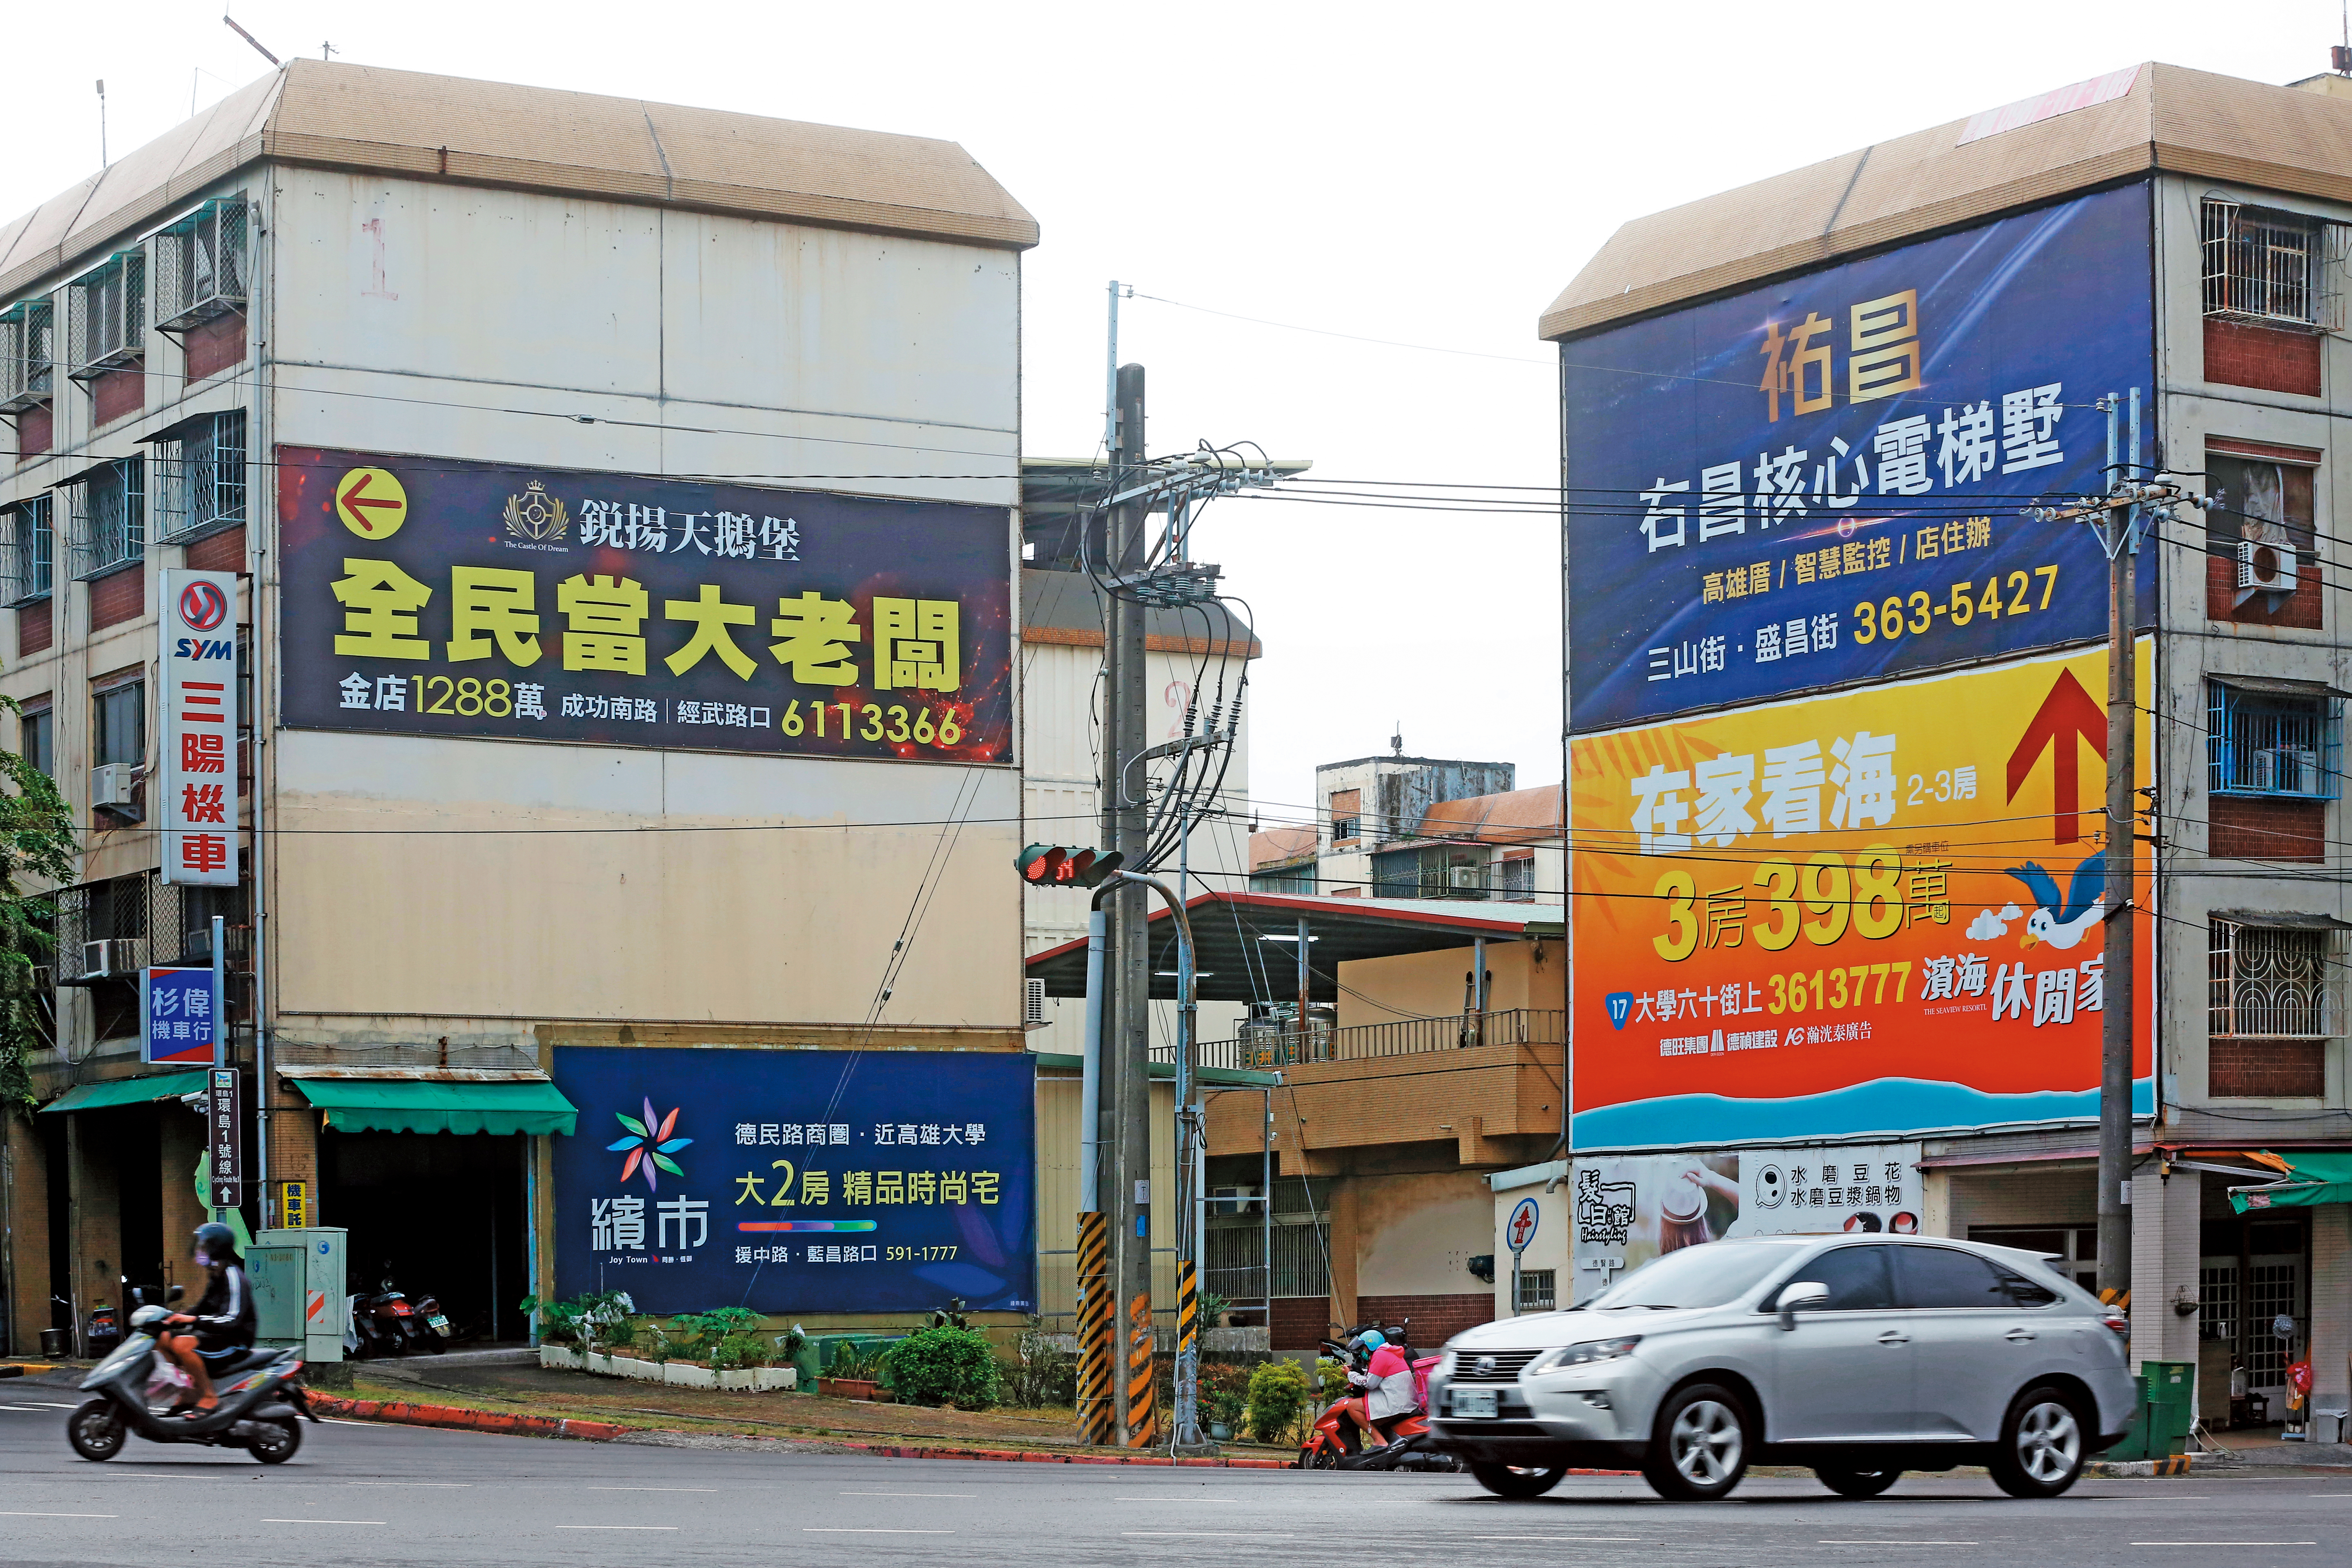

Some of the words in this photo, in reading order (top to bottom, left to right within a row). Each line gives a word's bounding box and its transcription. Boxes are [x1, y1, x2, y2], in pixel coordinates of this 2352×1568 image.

[1759, 289, 1921, 423] 祐昌
[1639, 382, 2064, 553] 右昌核心電梯墅
[548, 545, 568, 553] Dream
[1703, 561, 1771, 604] 高雄厝
[1795, 537, 1891, 585] 智慧監控
[1916, 517, 1991, 560] 店住辦
[330, 557, 960, 693] 全民當大老闆
[1853, 564, 2059, 646] 363-5427
[174, 638, 232, 661] SYM
[561, 694, 657, 724] 成功南路
[677, 699, 770, 728] 經武路口
[782, 699, 960, 745] 6113366
[181, 682, 226, 872] 三陽機車
[1631, 731, 1897, 858] 在家看海
[1907, 765, 1977, 806] 2-3房
[152, 987, 210, 1017] 杉偉
[1613, 999, 1627, 1019] 17
[1635, 982, 1762, 1023] 大學六十街上
[1768, 961, 1911, 1014] 3613777
[1936, 1006, 1961, 1014] SEAVIEW
[152, 1020, 211, 1041] 機車行
[1660, 1036, 1708, 1056] 德旺集團
[218, 1098, 232, 1174] 環島1號線
[212, 1176, 223, 1185] Cycling
[735, 1159, 829, 1207] 大2房
[843, 1170, 1000, 1206] 精品時尚宅
[1791, 1162, 1900, 1183] 水磨豆花
[287, 1184, 302, 1228] 機車託
[886, 1246, 958, 1261] 591-1777
[1581, 1227, 1628, 1245] Hairstyling
[609, 1256, 623, 1265] Joy
